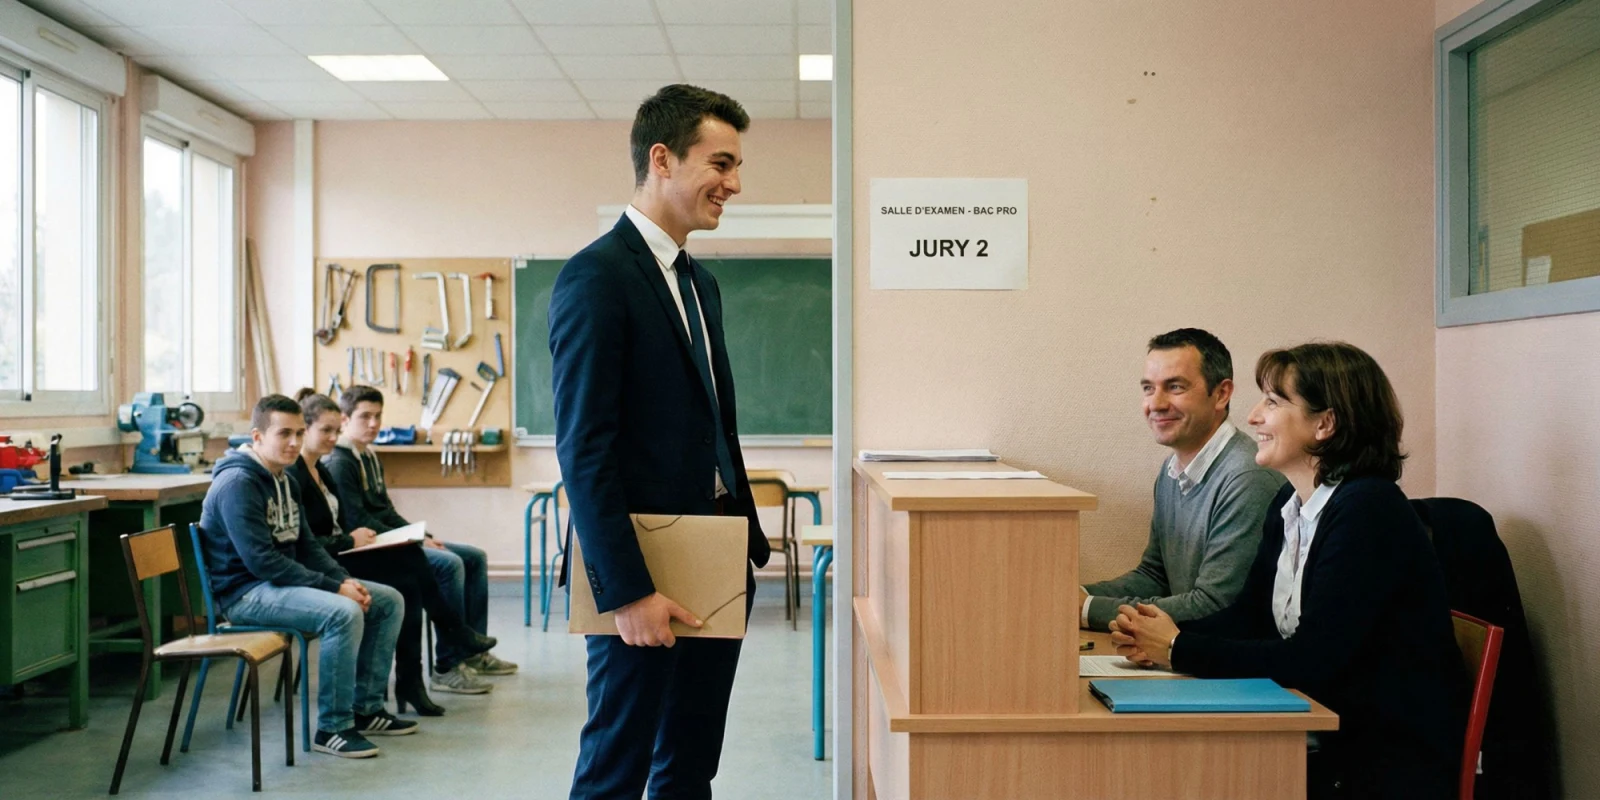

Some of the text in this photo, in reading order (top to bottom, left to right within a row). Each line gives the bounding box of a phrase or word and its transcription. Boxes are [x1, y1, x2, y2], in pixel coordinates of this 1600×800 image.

[881, 206, 912, 215] SALLE
[915, 206, 965, 215] D'EXAMEN
[973, 206, 994, 215] BAC
[996, 206, 1017, 215] PRO
[909, 239, 989, 257] JURY 2
